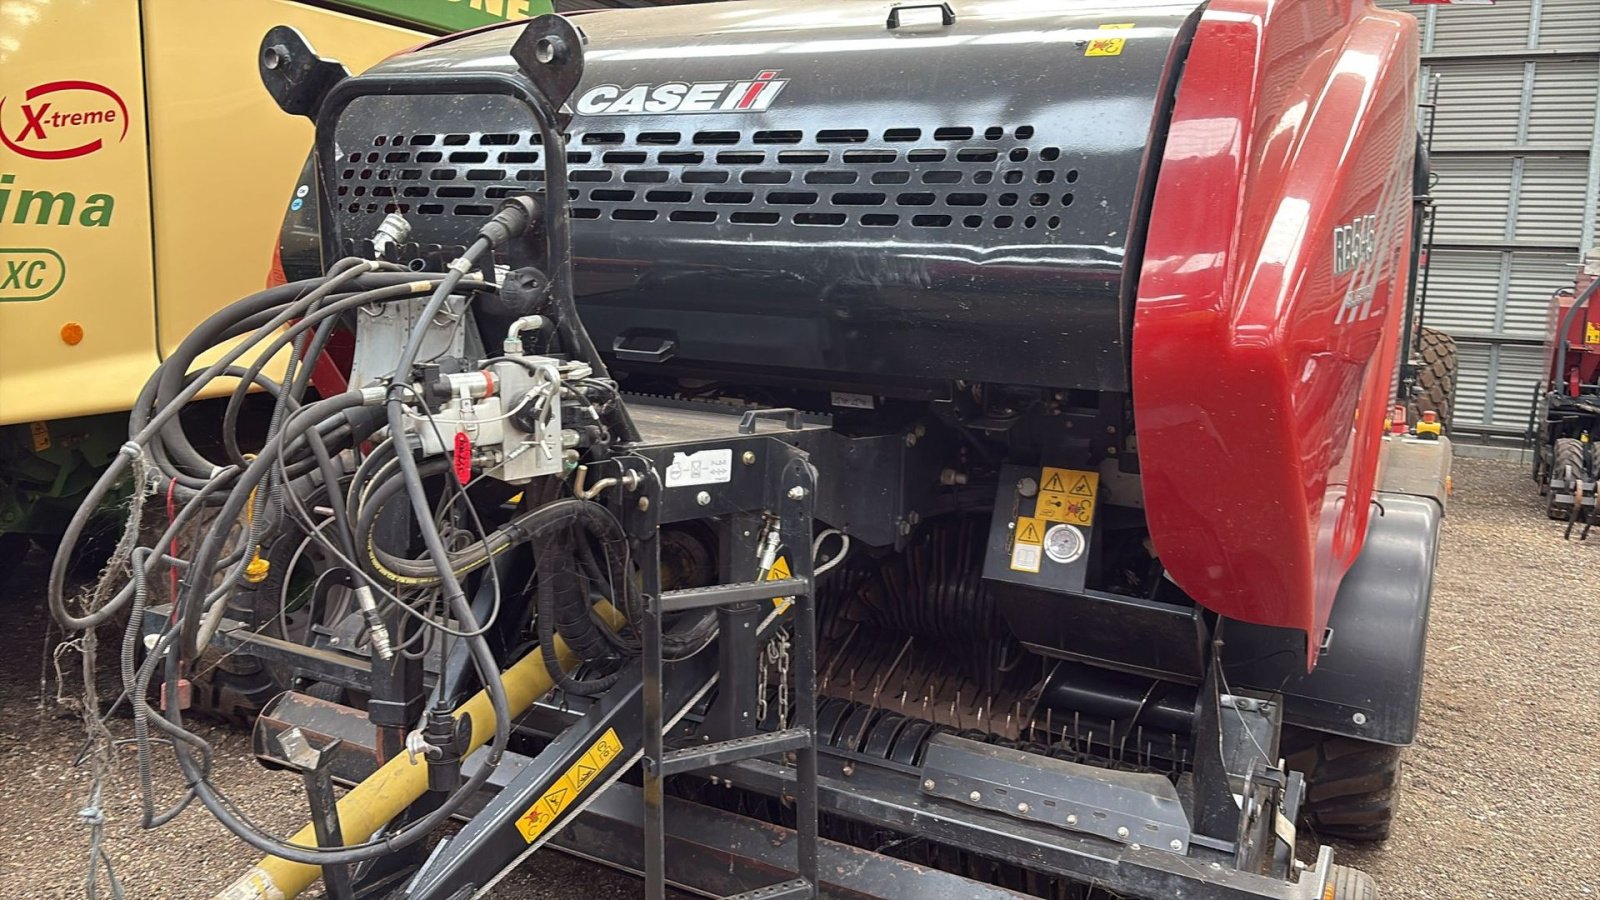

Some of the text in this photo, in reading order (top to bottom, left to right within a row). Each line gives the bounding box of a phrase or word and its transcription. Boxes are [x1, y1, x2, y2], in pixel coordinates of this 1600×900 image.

[576, 82, 729, 114] CASE
[15, 103, 116, 142] X-treme
[0, 260, 46, 290] XC
